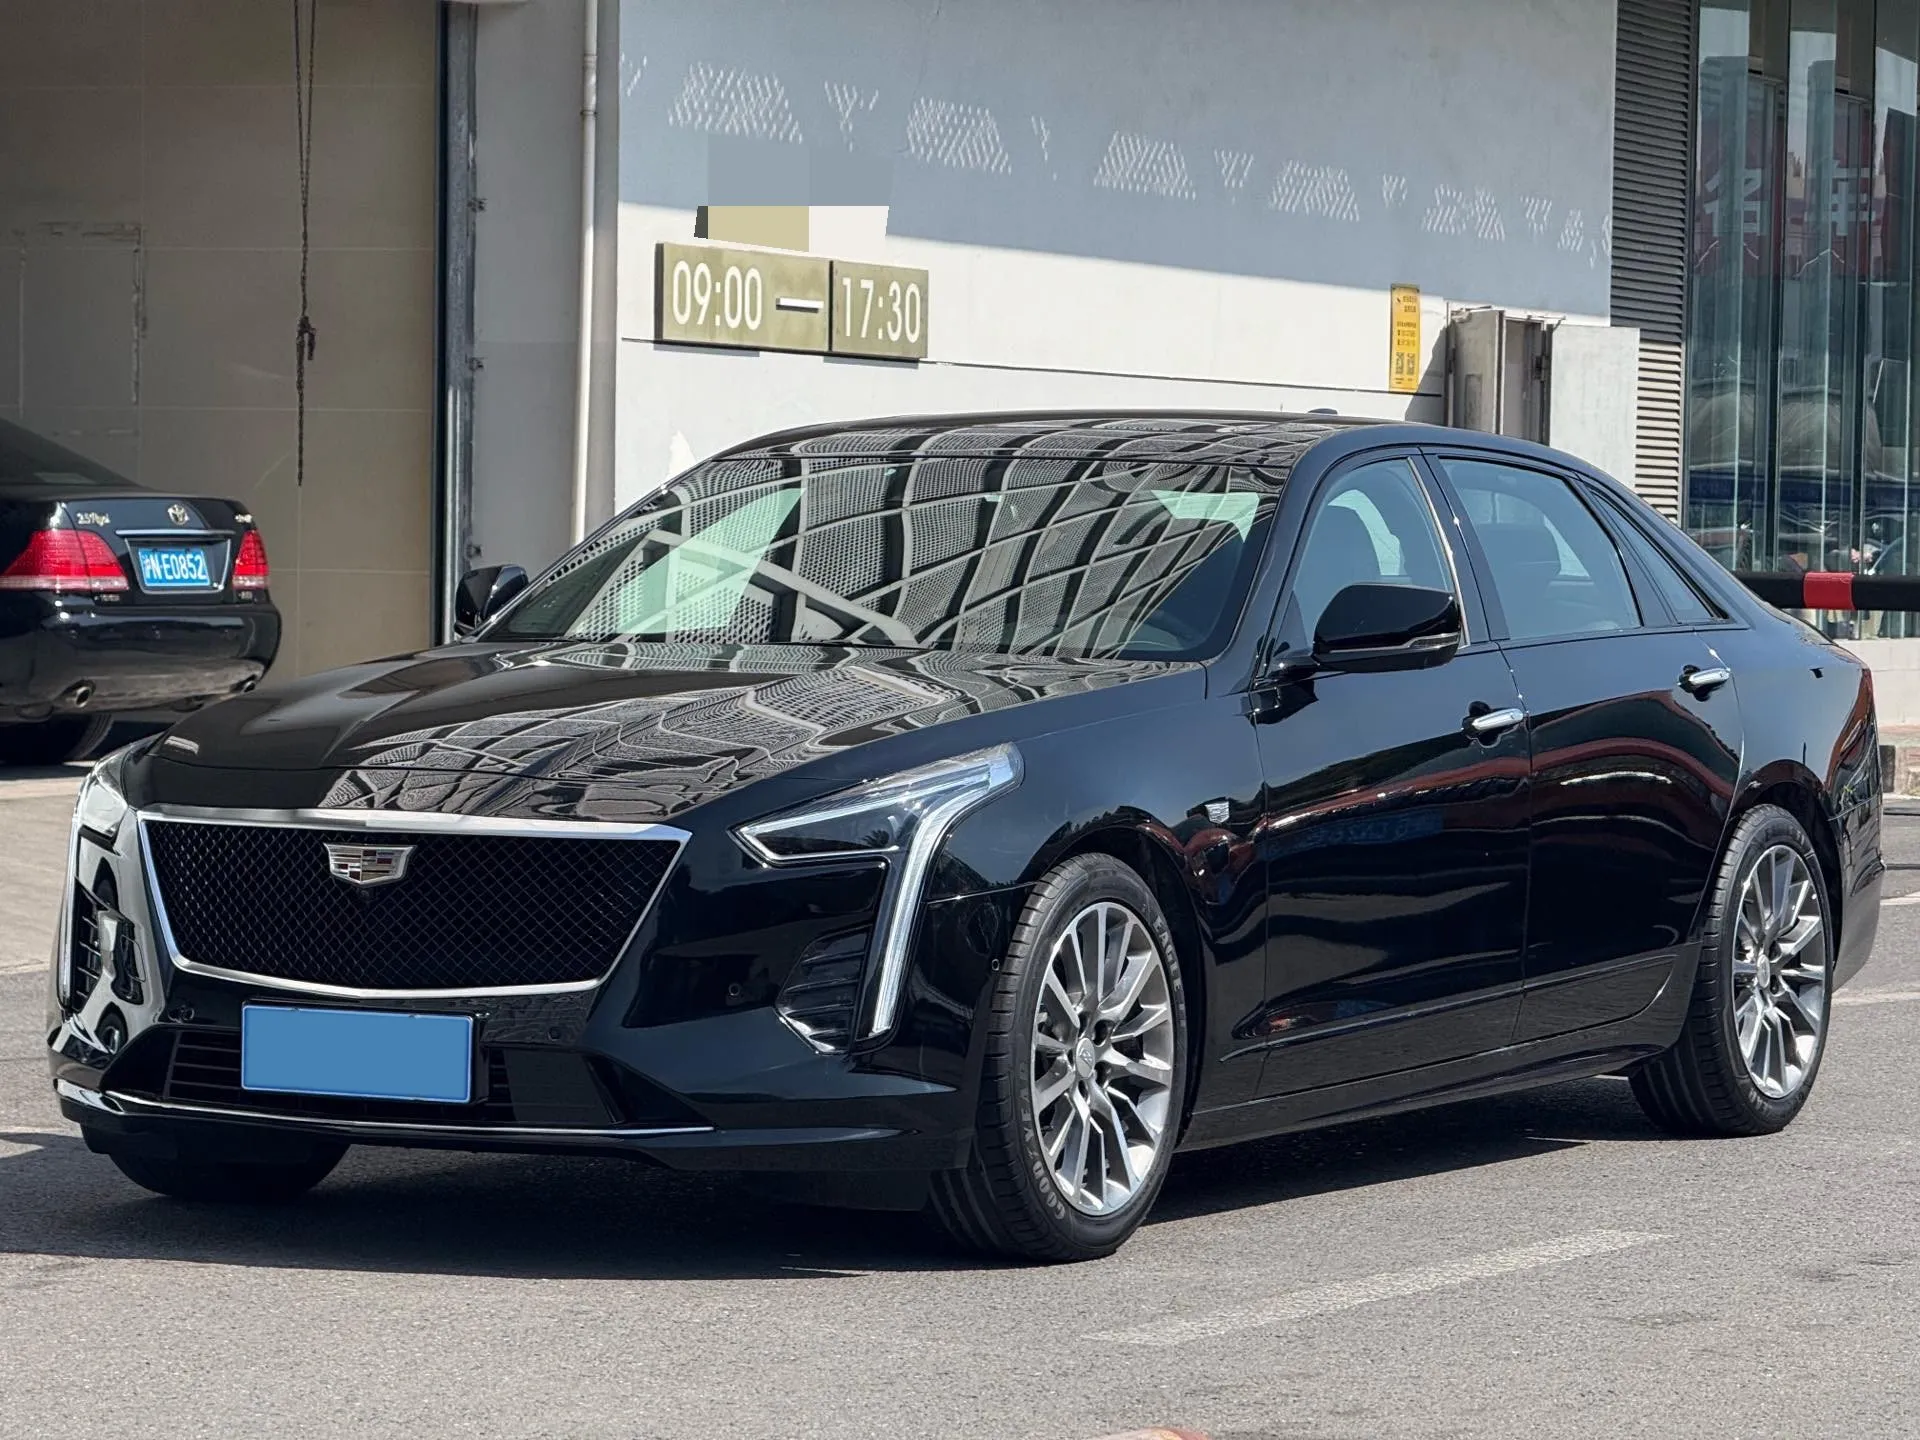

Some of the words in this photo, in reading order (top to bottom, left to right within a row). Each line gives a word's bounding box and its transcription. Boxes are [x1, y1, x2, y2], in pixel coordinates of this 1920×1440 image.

[672, 260, 762, 331] 09:00
[842, 277, 921, 344] 17:30
[1153, 915, 1181, 992] EAGLE
[1019, 1061, 1066, 1220] GOODYEAR
